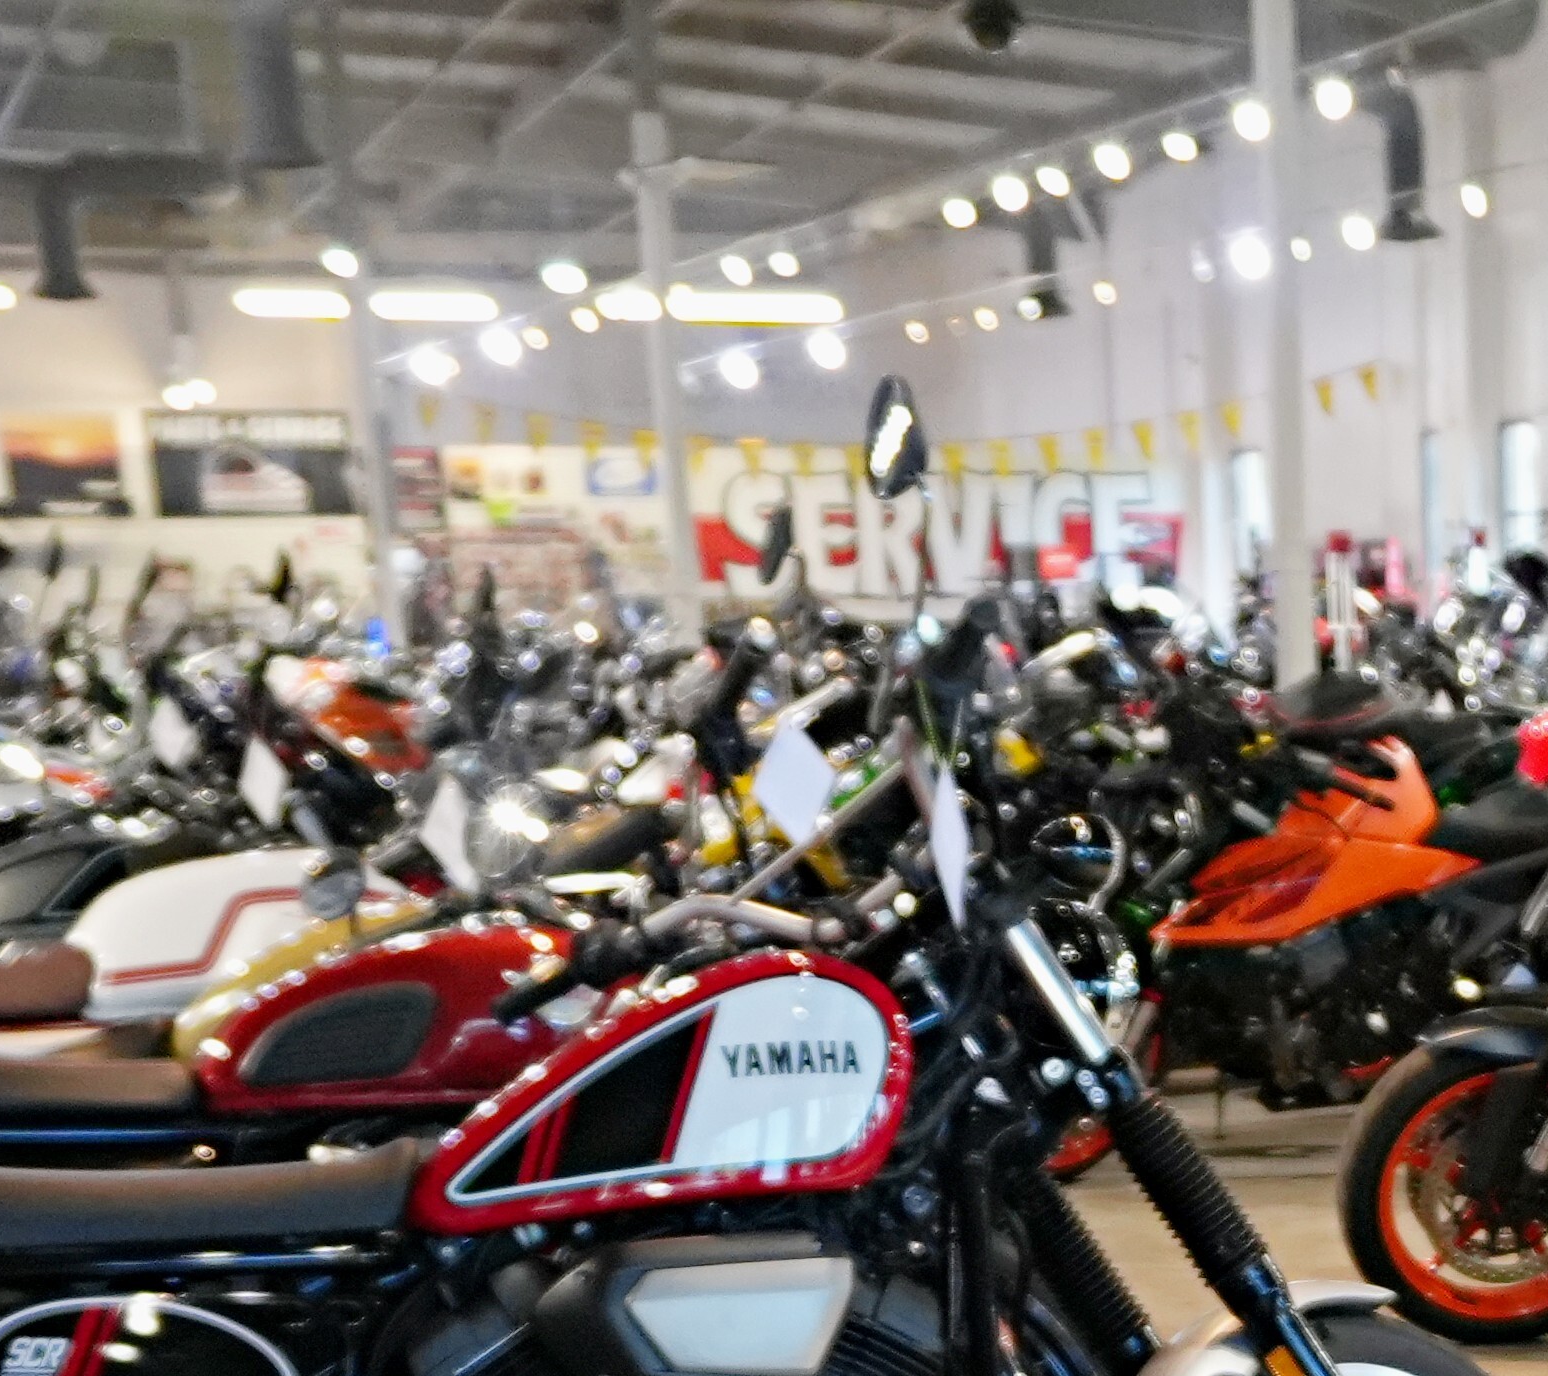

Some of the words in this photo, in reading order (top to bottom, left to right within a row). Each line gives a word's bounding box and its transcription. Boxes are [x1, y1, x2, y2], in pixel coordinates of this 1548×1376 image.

[724, 470, 1158, 600] SERVICE
[721, 1038, 862, 1078] YAMAHA
[2, 1336, 71, 1369] SCR
